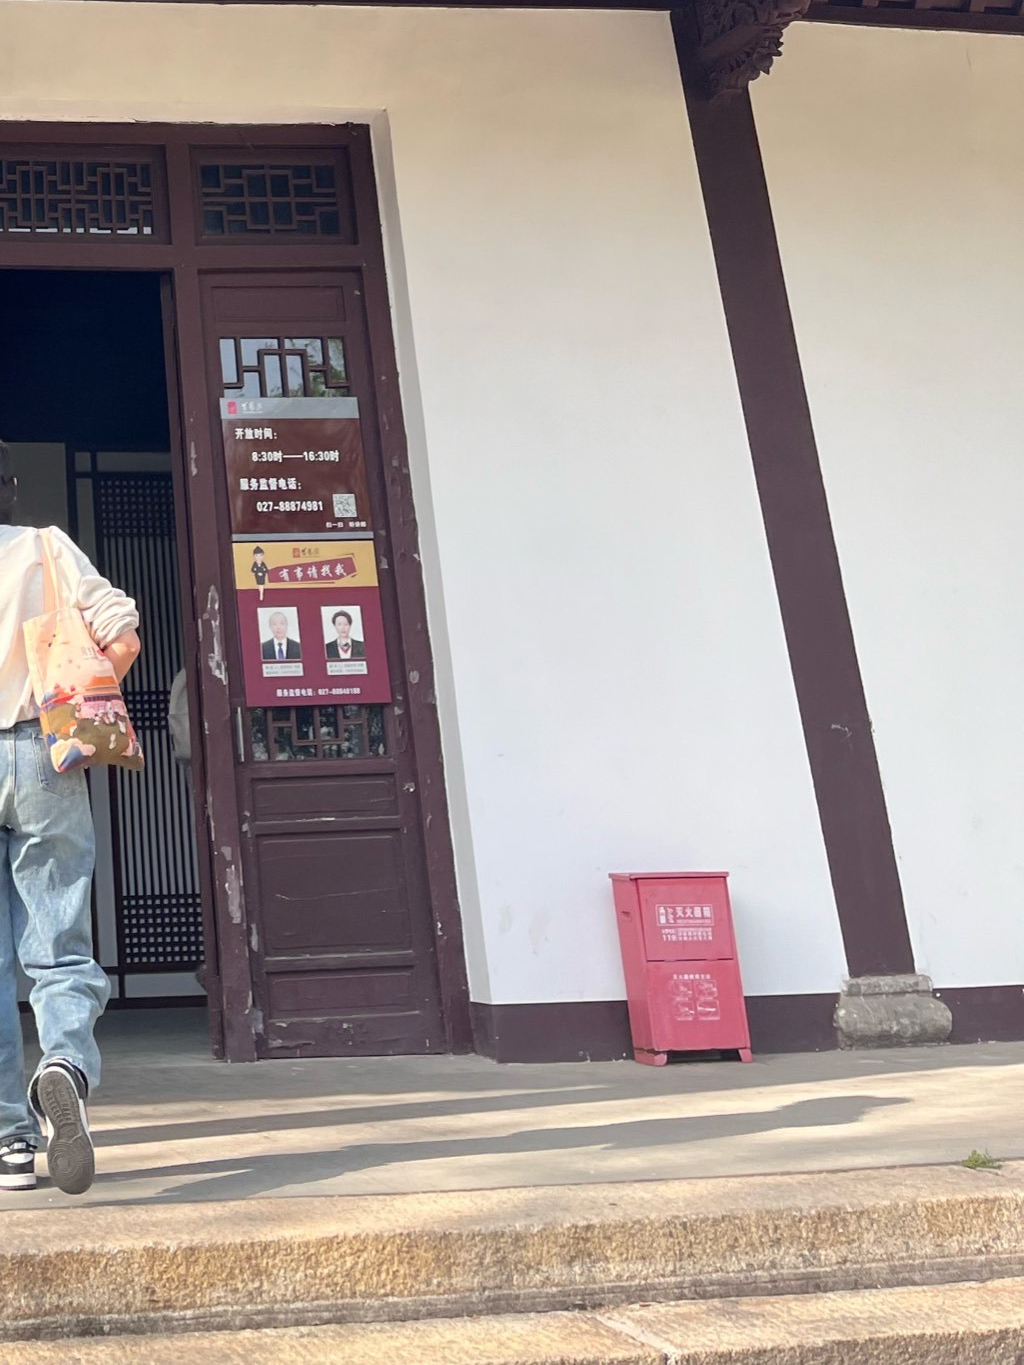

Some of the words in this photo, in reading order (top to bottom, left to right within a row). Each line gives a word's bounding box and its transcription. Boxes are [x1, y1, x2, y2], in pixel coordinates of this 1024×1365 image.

[235, 428, 278, 440] 开放时间：
[256, 501, 324, 512] 027-88874981
[279, 563, 347, 581] 有事请找我
